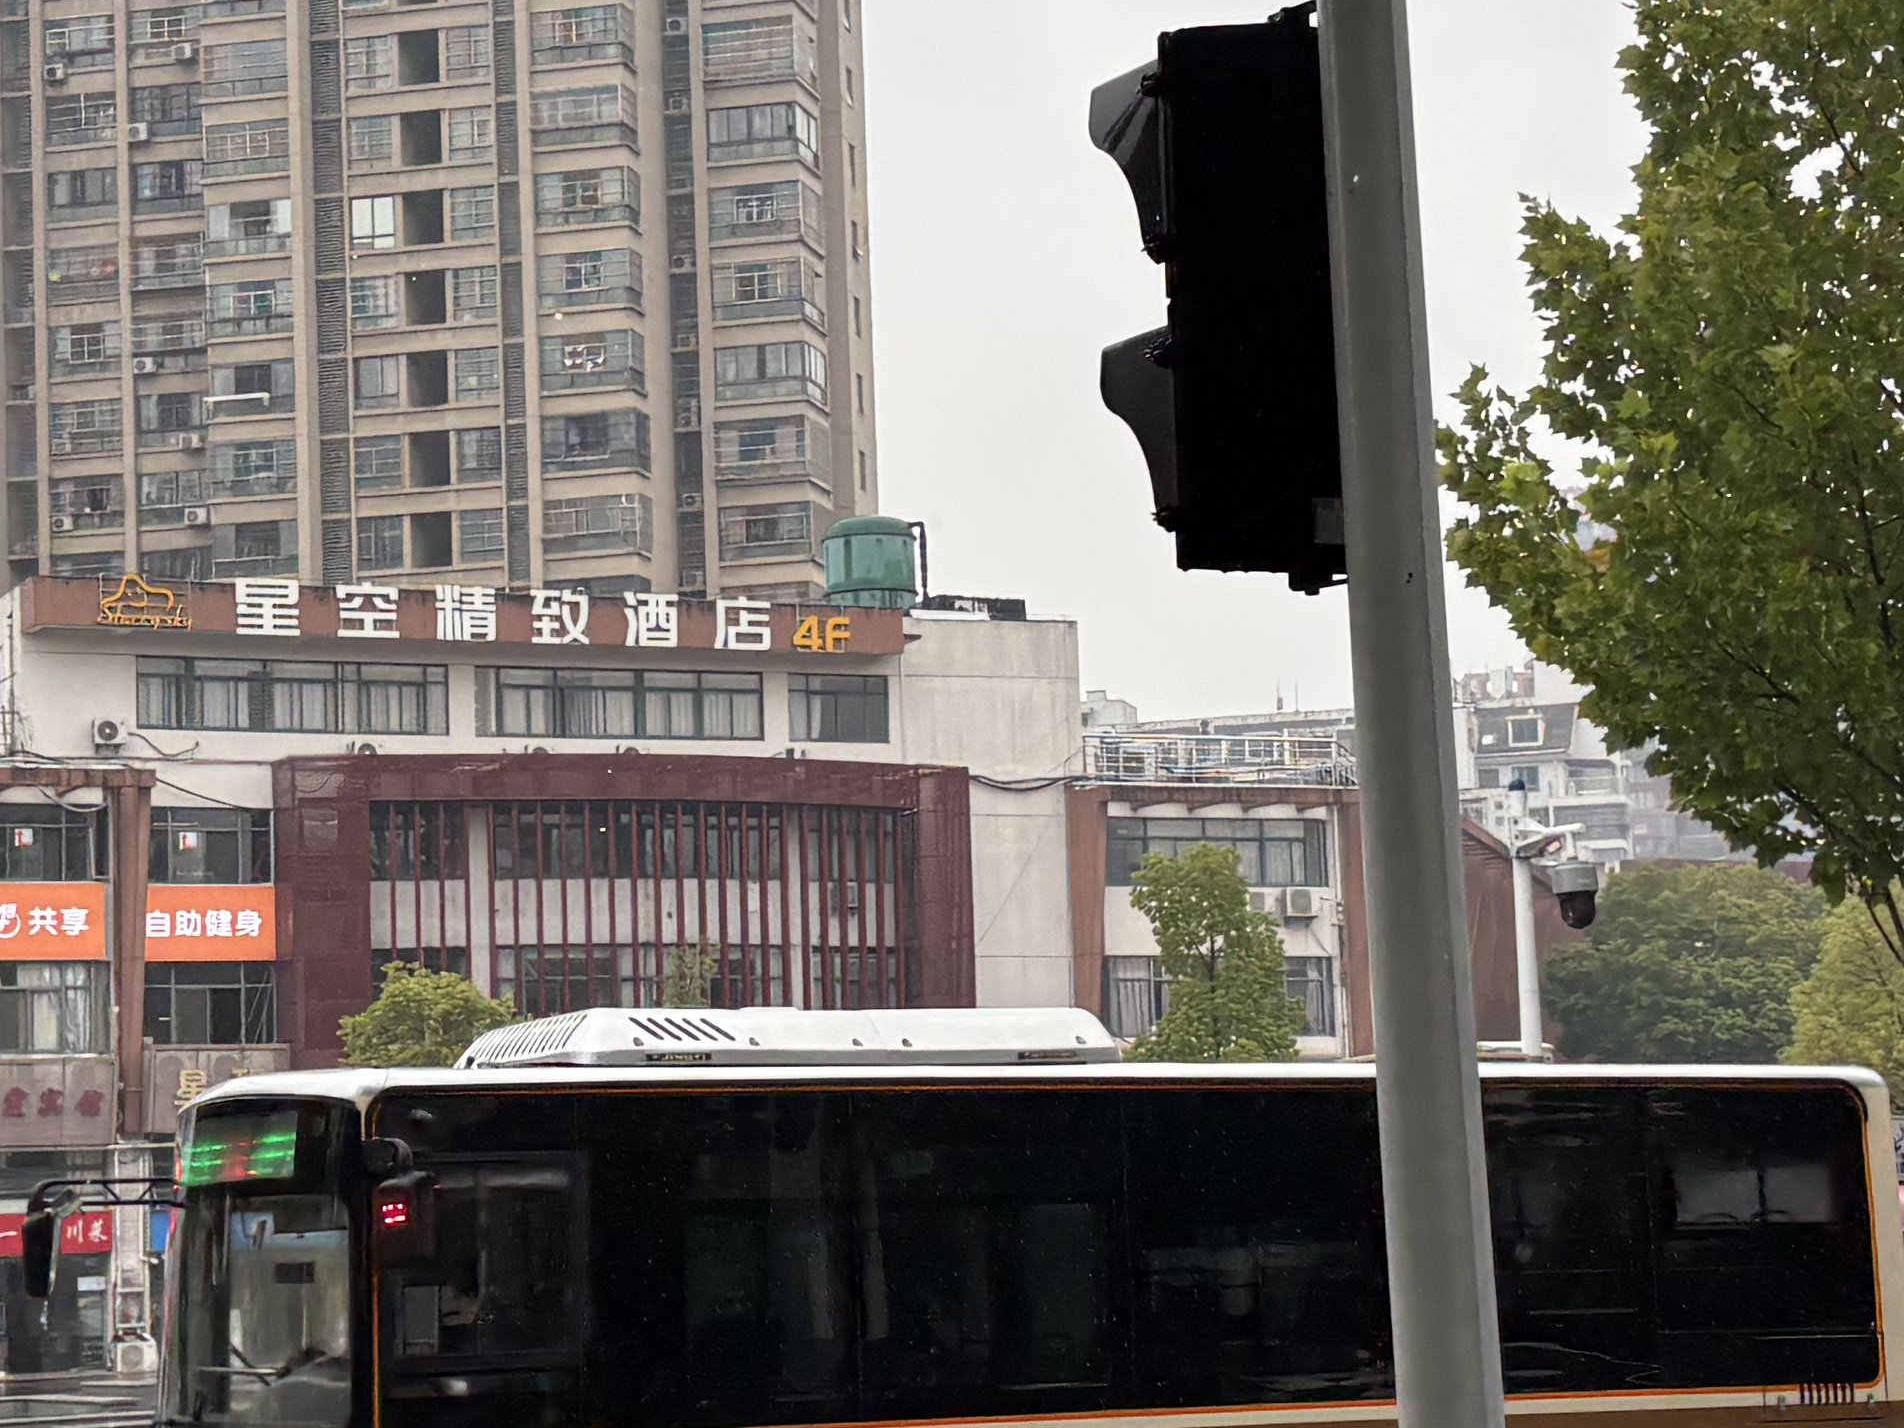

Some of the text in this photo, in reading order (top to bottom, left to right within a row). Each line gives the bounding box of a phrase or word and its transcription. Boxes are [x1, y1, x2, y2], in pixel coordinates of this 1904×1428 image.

[235, 577, 851, 652] 星空精致酒店 4F
[28, 907, 90, 936] 共享
[145, 909, 263, 938] 自助健身
